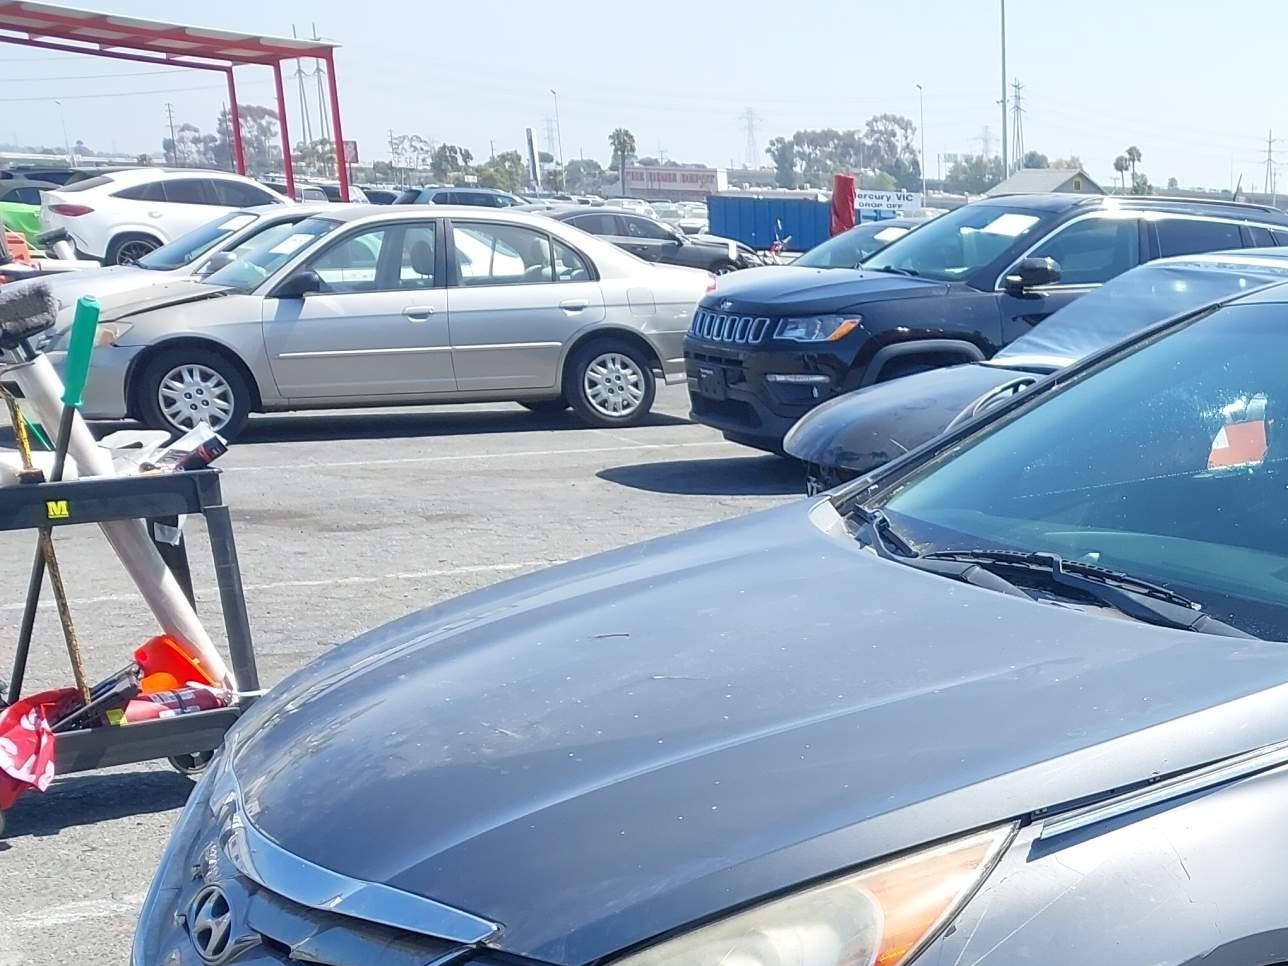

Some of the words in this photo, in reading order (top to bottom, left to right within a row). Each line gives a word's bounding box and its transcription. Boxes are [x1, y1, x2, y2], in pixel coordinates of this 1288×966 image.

[855, 193, 892, 202] ercury
[896, 193, 914, 201] VIC
[46, 500, 70, 518] M
